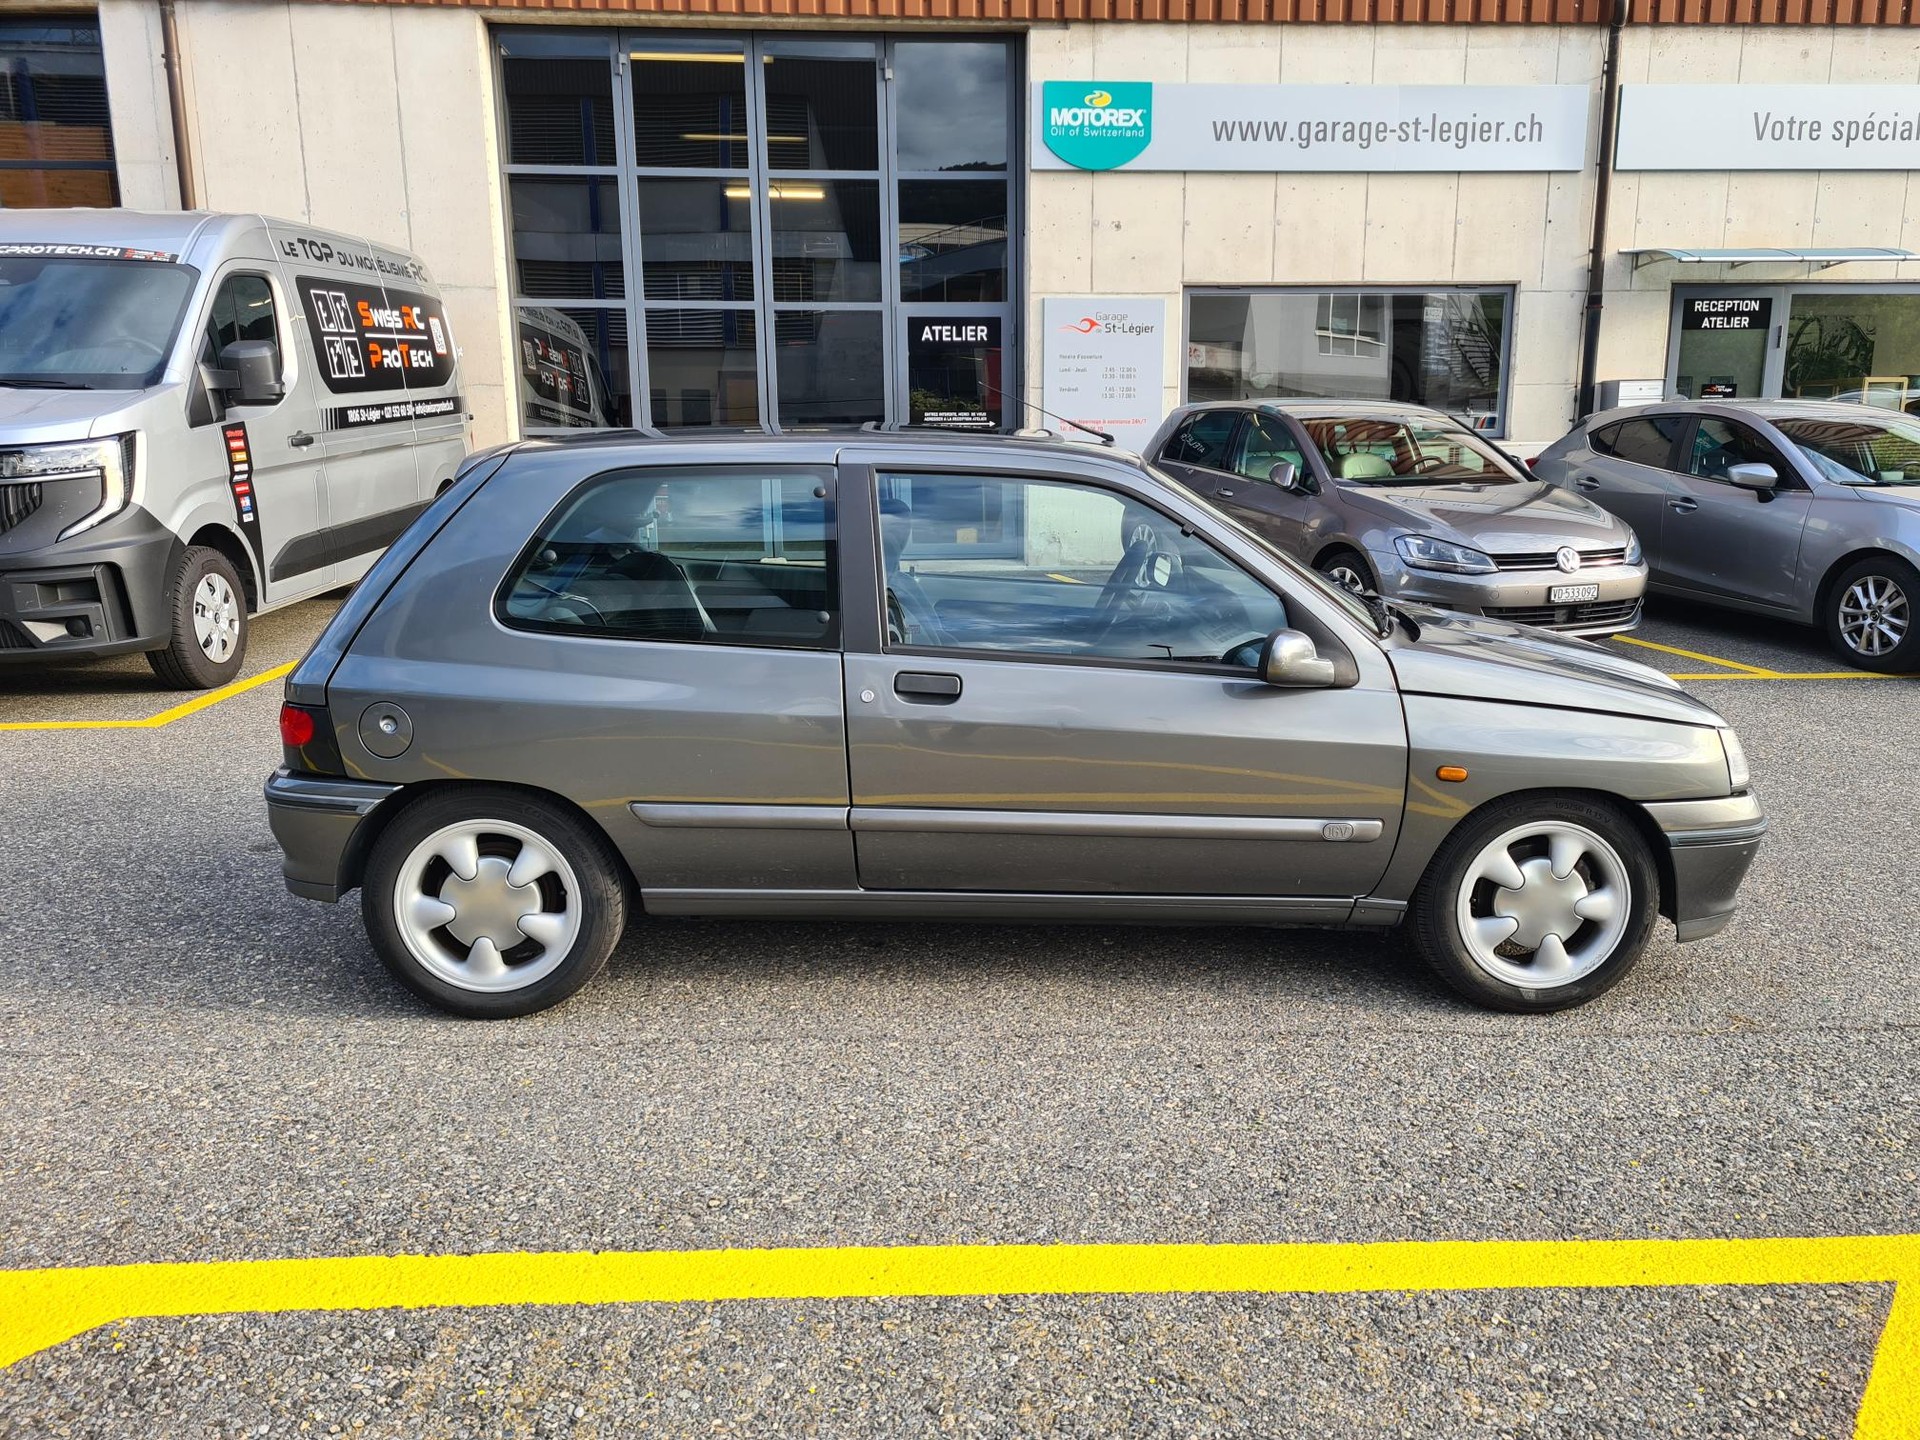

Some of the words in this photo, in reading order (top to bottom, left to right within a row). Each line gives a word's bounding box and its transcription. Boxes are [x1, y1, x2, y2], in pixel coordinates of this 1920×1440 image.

[1050, 107, 1144, 127] MOTOREX
[1050, 127, 1065, 137] Oil
[1069, 127, 1080, 137] of
[1083, 127, 1145, 137] Switzerland
[1212, 112, 1544, 150] www.garage-st-legier.ch
[1753, 111, 1822, 141] Votre
[279, 239, 299, 258] LE
[297, 237, 334, 263] TOP
[336, 250, 355, 268] DU
[409, 259, 429, 283] RC
[1694, 300, 1760, 312] RECEPTION
[401, 305, 425, 331] RC
[1095, 311, 1129, 323] Garage
[1701, 316, 1750, 329] ATELIER
[921, 325, 988, 342] ATELIER
[1104, 322, 1155, 336] St-Légier
